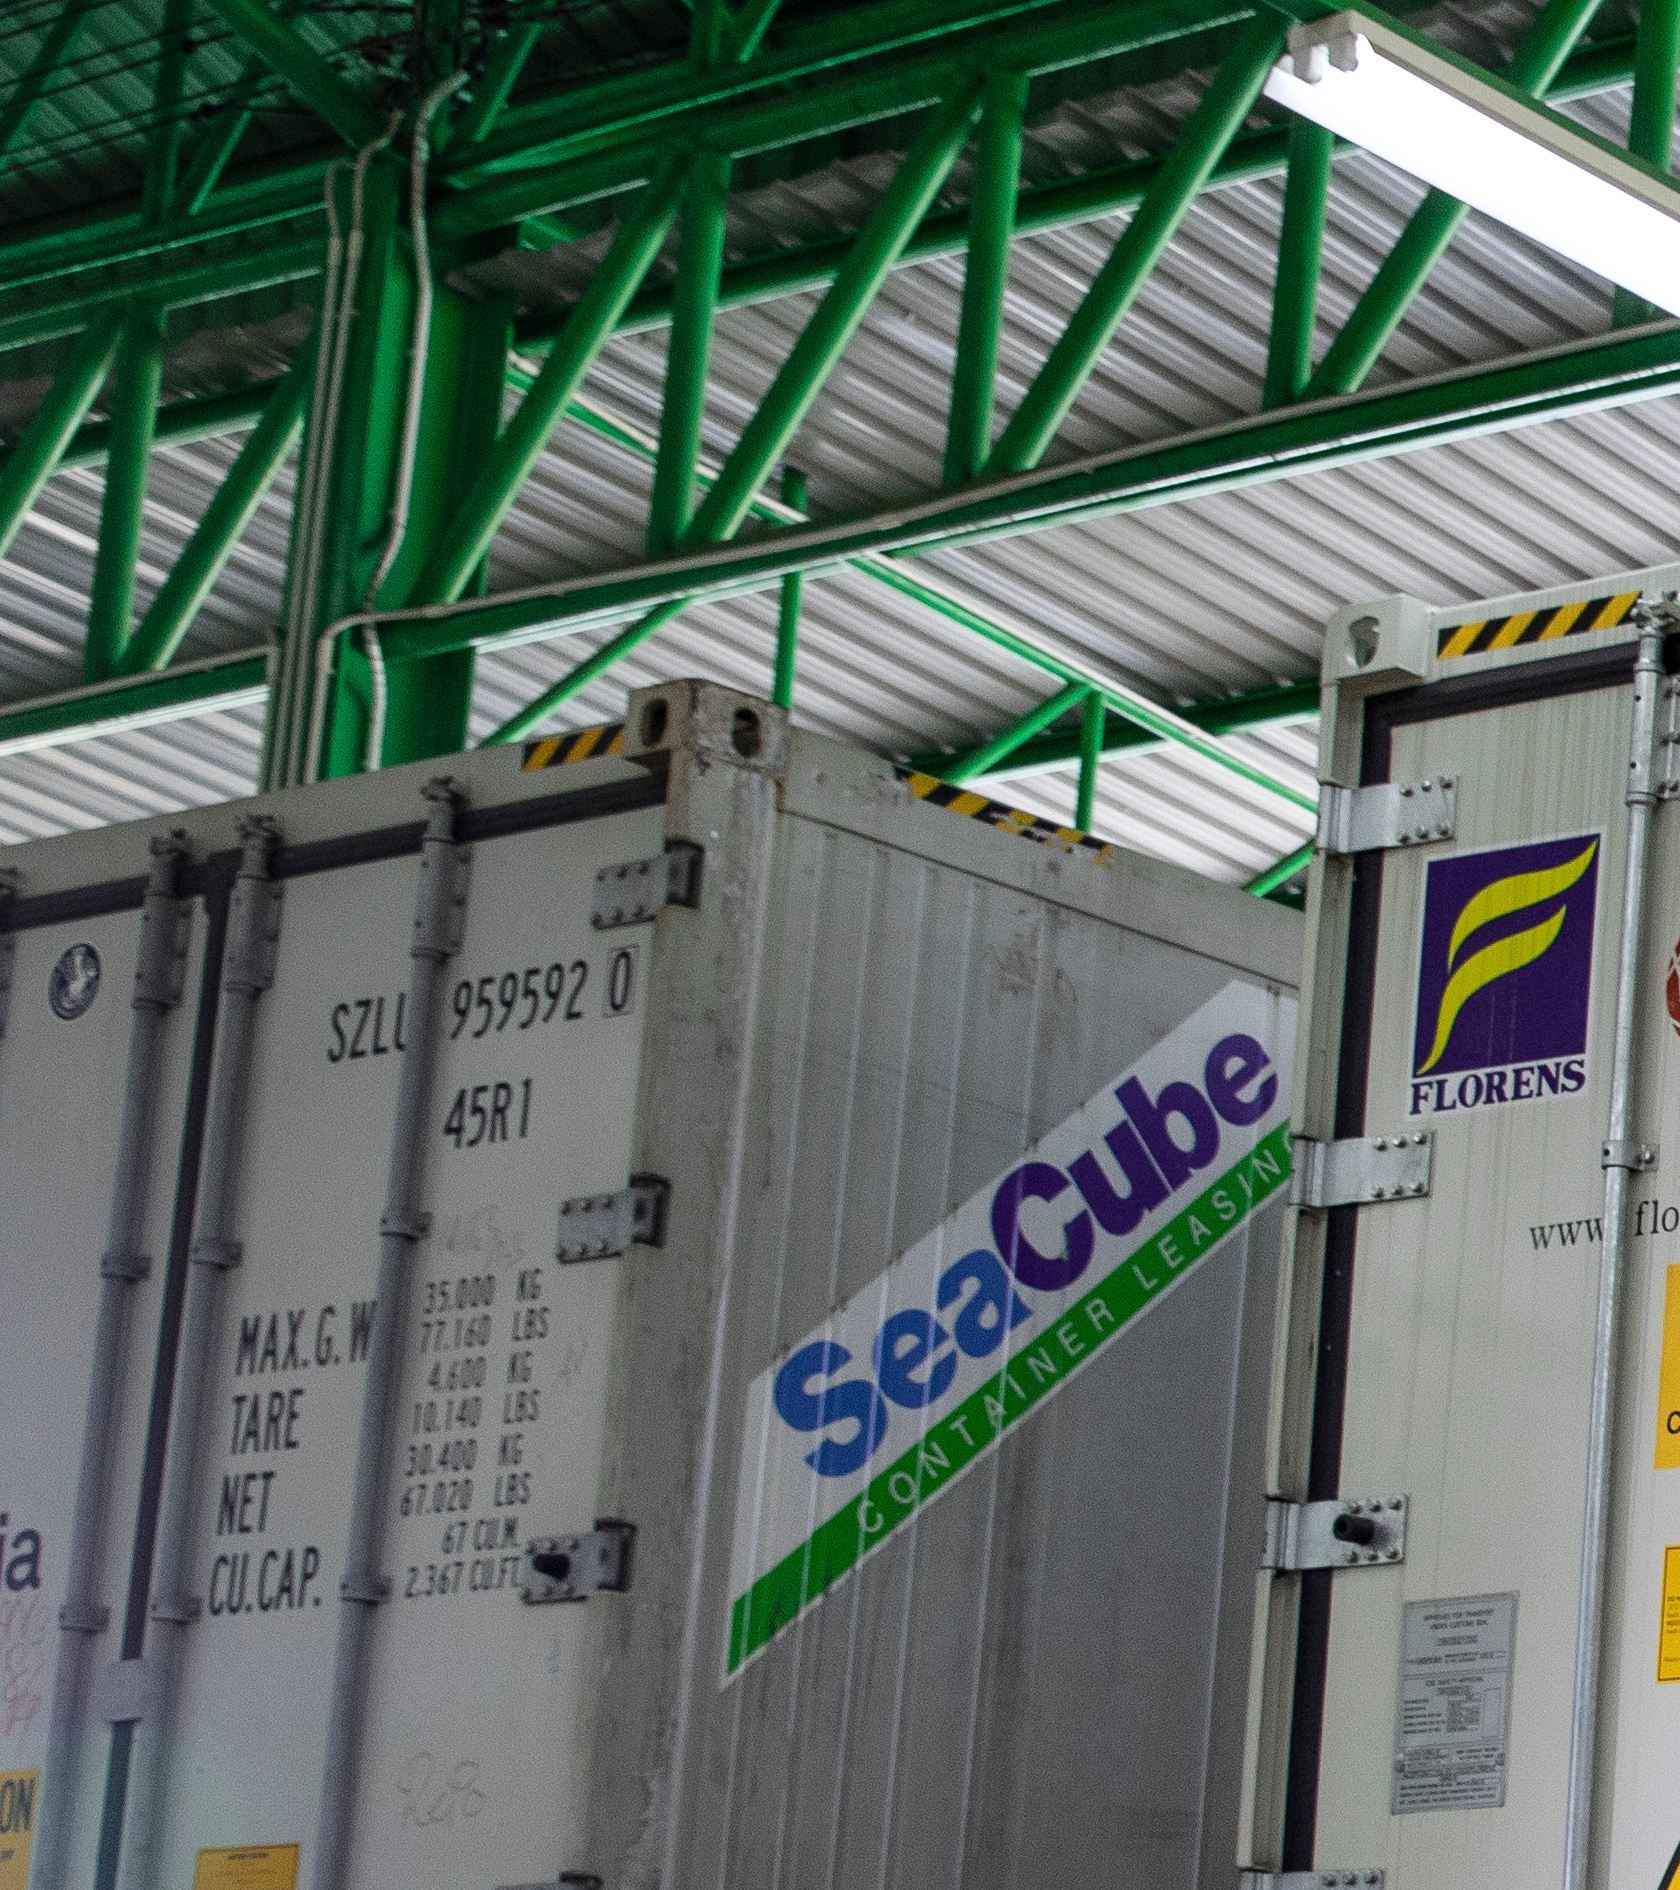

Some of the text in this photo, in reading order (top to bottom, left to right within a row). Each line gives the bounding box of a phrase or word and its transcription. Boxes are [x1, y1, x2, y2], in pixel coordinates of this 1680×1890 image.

[451, 960, 588, 1040] 959592
[443, 1077, 533, 1150] 45R1
[1410, 1058, 1586, 1116] FLORENS
[773, 1031, 1279, 1478] SeaCube
[422, 1274, 496, 1314] 35.000
[514, 1267, 544, 1300] KG
[420, 1306, 550, 1354] 77.160 LBS
[230, 1388, 306, 1456] TARE
[506, 1350, 535, 1384] KG
[502, 1389, 541, 1425] LBS
[856, 1297, 1114, 1534] CONTAINER
[215, 1471, 277, 1537] NET
[497, 1433, 525, 1466] KG
[493, 1471, 532, 1507] LBS
[440, 1519, 469, 1556] 67
[207, 1545, 322, 1616] CU.CAP.
